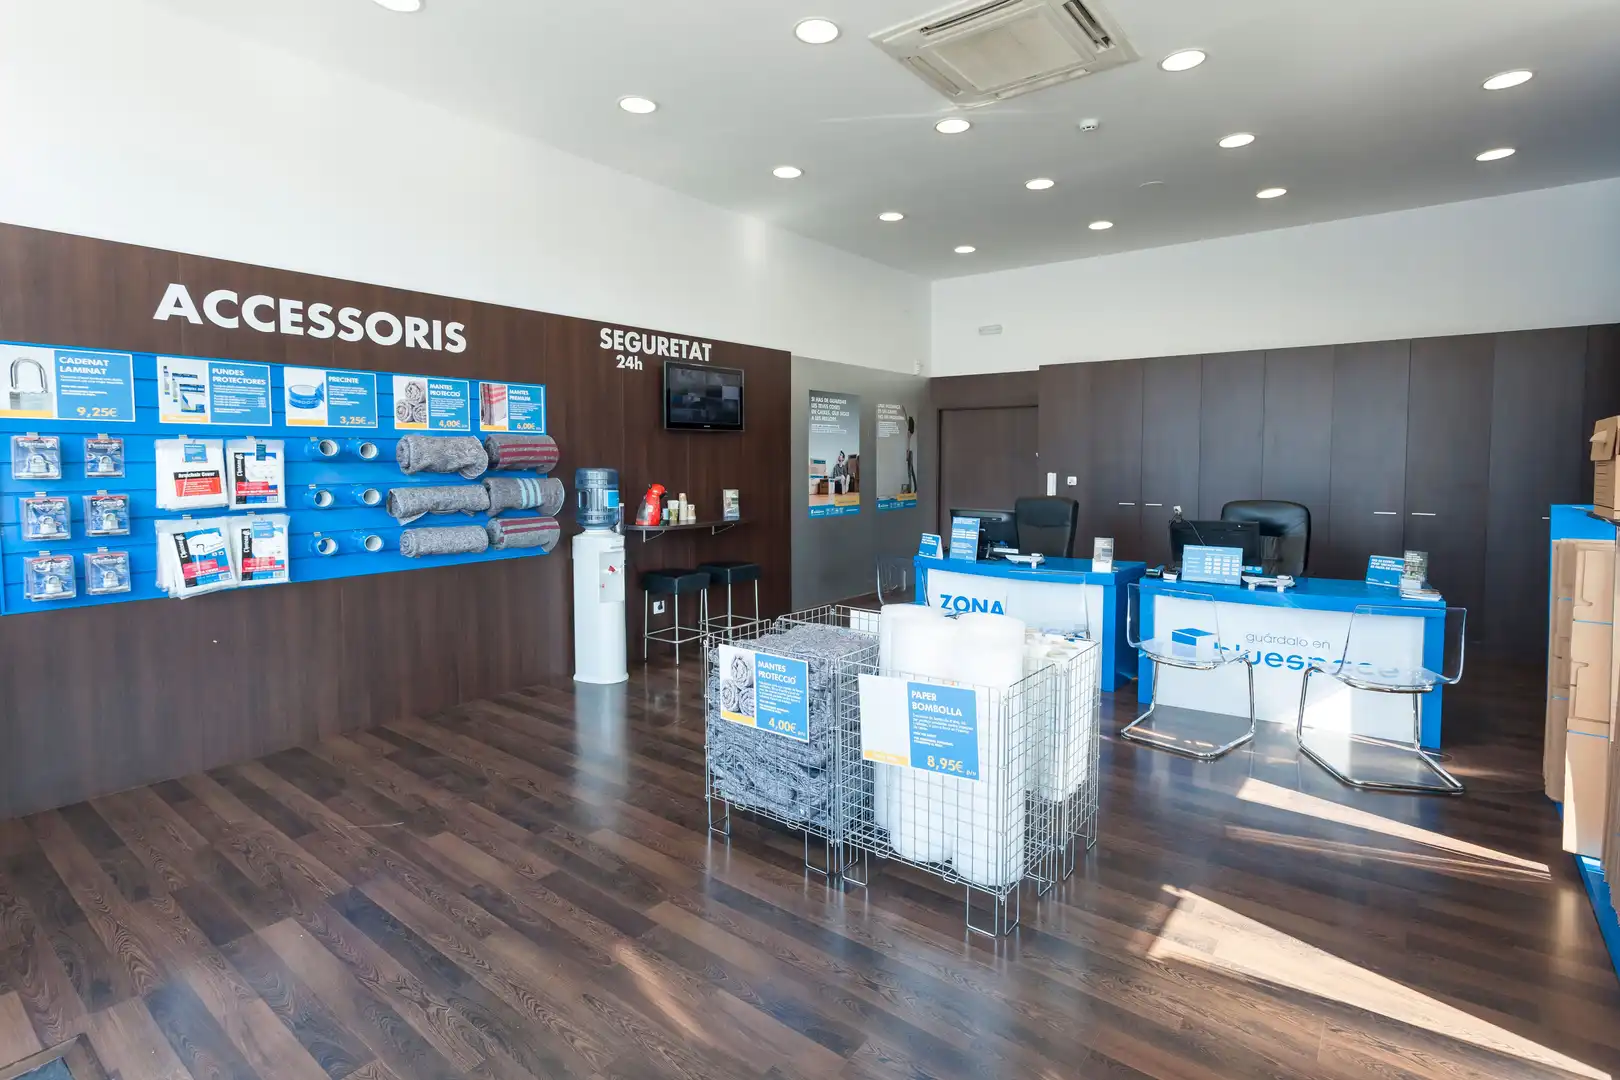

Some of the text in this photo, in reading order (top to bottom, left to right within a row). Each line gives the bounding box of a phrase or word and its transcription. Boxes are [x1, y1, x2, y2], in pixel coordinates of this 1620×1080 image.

[153, 283, 467, 353] ACCESSORIS
[600, 327, 712, 362] SEGURETAT
[59, 356, 110, 366] CADENAT
[616, 354, 643, 370] 24h
[59, 365, 108, 375] LAMINAT
[212, 367, 245, 376] FUNDES
[212, 376, 267, 385] PROTECTORES
[328, 375, 359, 384] PRECINTE
[76, 406, 117, 417] 9,25€
[340, 415, 367, 425] 3,25€
[439, 419, 461, 428] 4,00€
[516, 422, 536, 430] 6,00€
[940, 593, 1005, 615] ZONA
[1245, 632, 1331, 650] guárdalo en
[757, 660, 787, 673] MANTES
[758, 670, 797, 685] PROTECCIÓ
[911, 689, 937, 702] PAPER
[912, 701, 963, 716] BOMBOLLA
[768, 717, 797, 734] 4,00€
[927, 755, 964, 773] 8,95€
